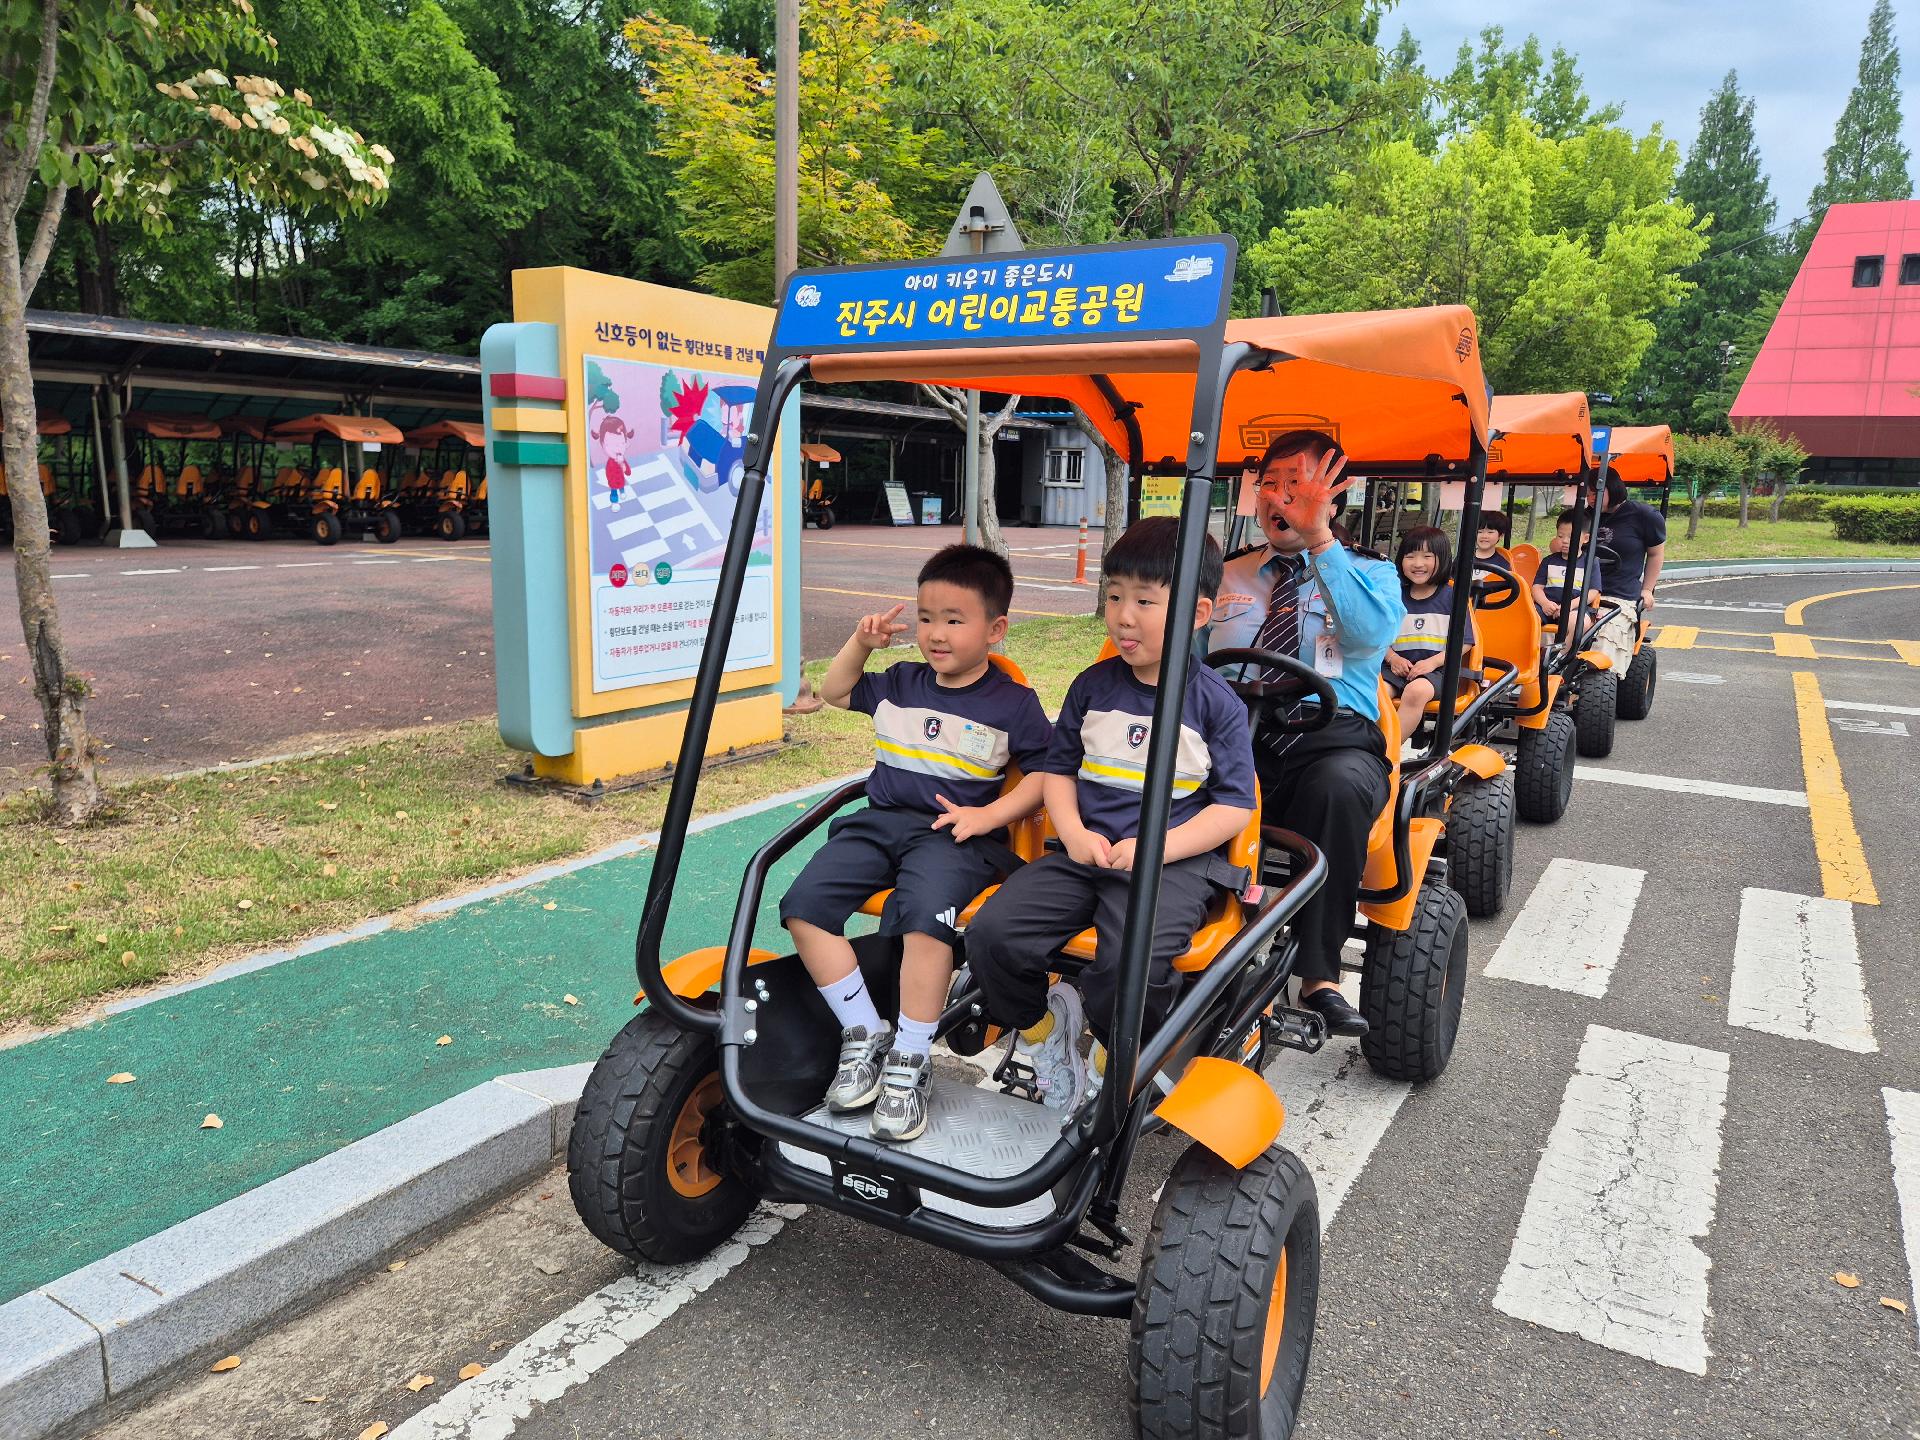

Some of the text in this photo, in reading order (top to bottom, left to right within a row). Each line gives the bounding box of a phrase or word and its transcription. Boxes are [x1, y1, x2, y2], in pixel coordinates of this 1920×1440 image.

[904, 273, 938, 290] 아이
[946, 268, 997, 287] 키우기
[836, 282, 1144, 337] 진주시 어린이교통공원
[594, 321, 652, 349] 신호등이
[656, 331, 683, 353] 없는
[685, 339, 733, 361] 횡단보도를
[736, 347, 754, 363] 건널
[634, 569, 649, 578] 보다
[609, 624, 637, 638] 횡단보도를
[638, 623, 650, 635] 건널
[842, 1175, 889, 1199] BERG
